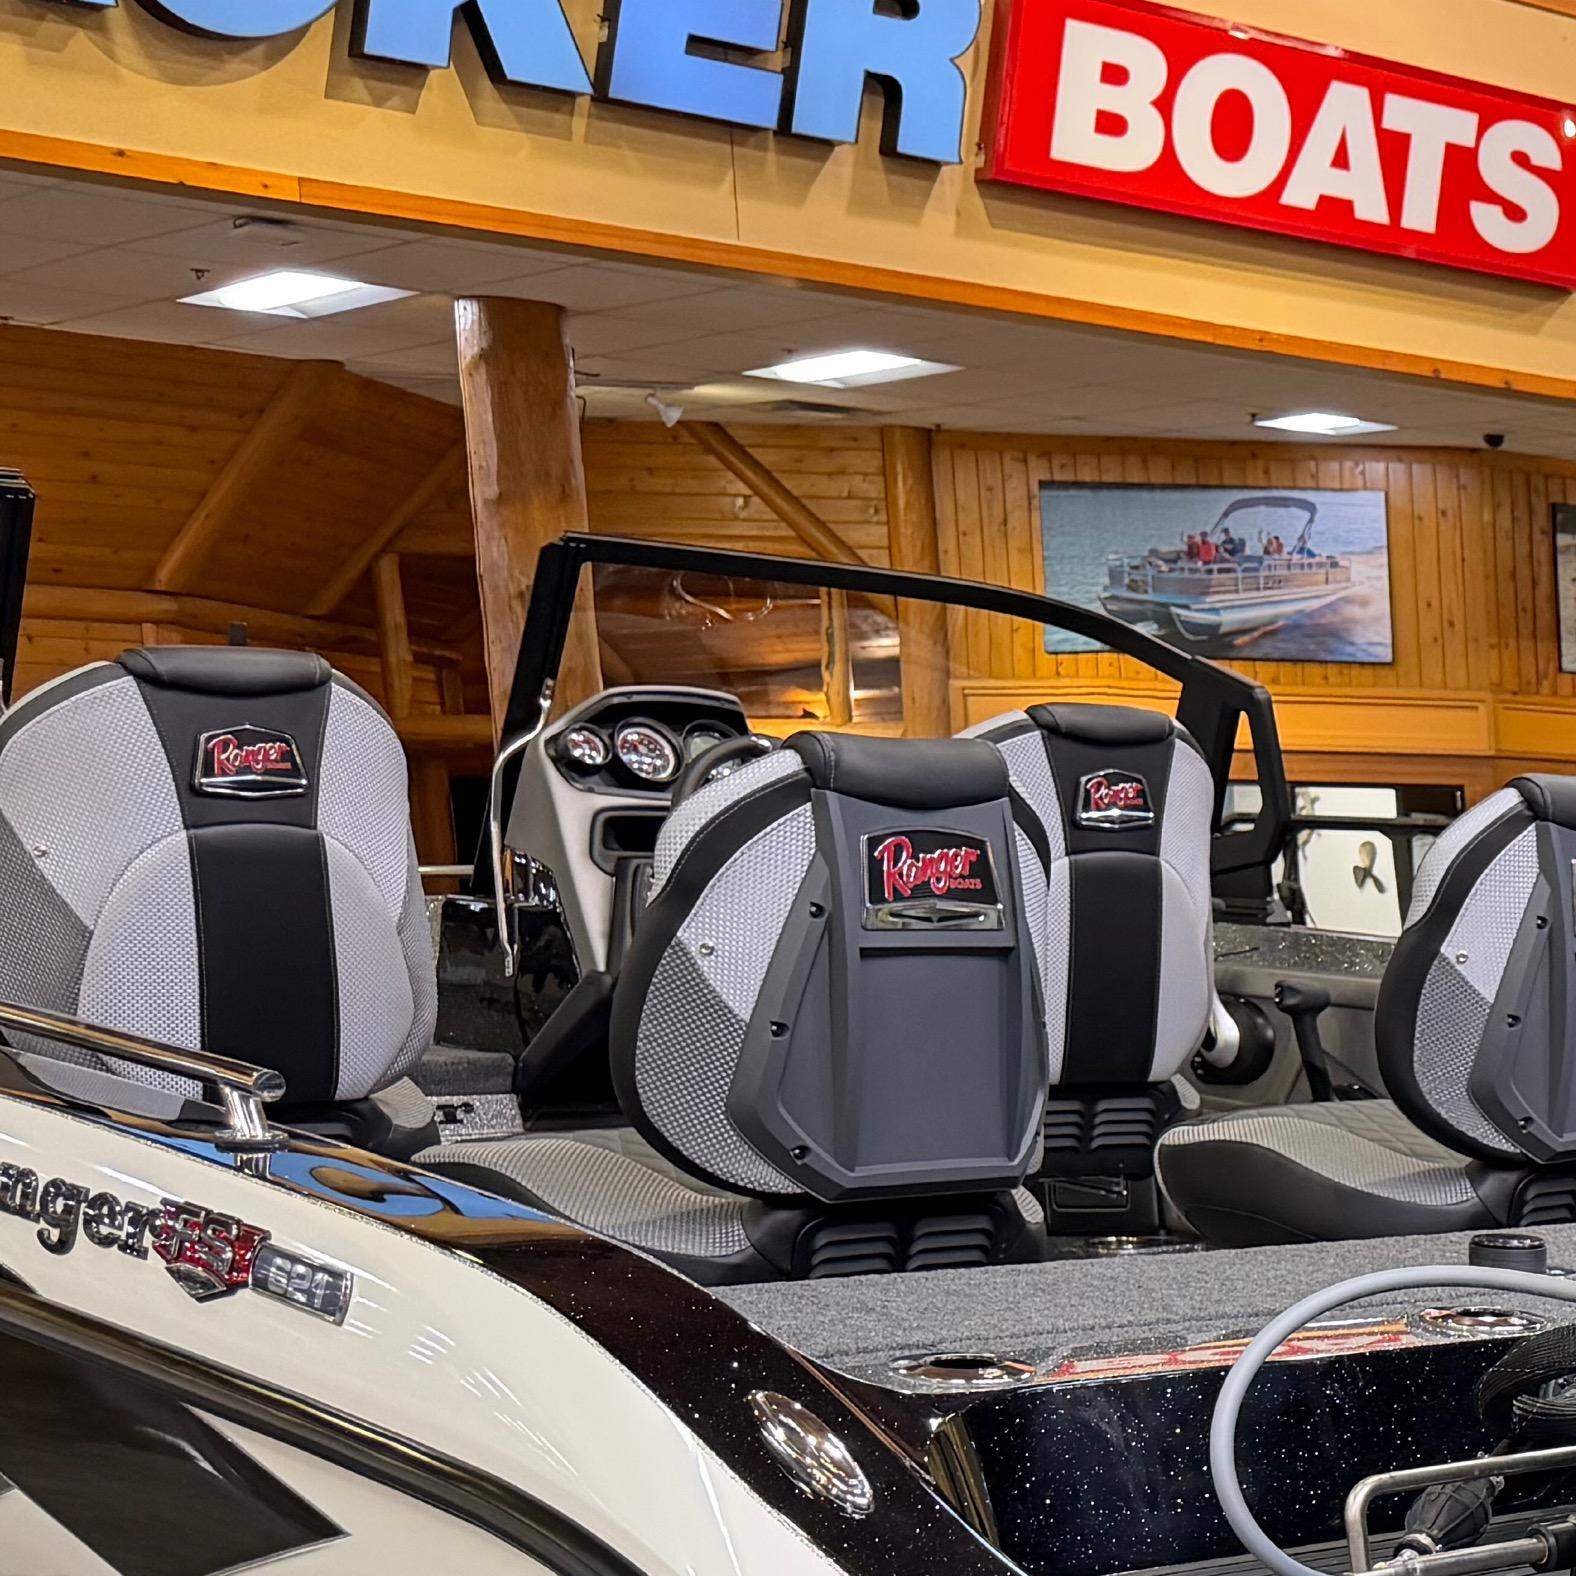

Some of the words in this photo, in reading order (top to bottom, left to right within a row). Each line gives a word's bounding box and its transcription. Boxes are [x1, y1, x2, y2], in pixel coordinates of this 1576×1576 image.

[1049, 18, 1564, 256] BOATS
[207, 734, 291, 777] Ranger
[874, 835, 981, 902] Ranger
[949, 878, 983, 890] BOATS
